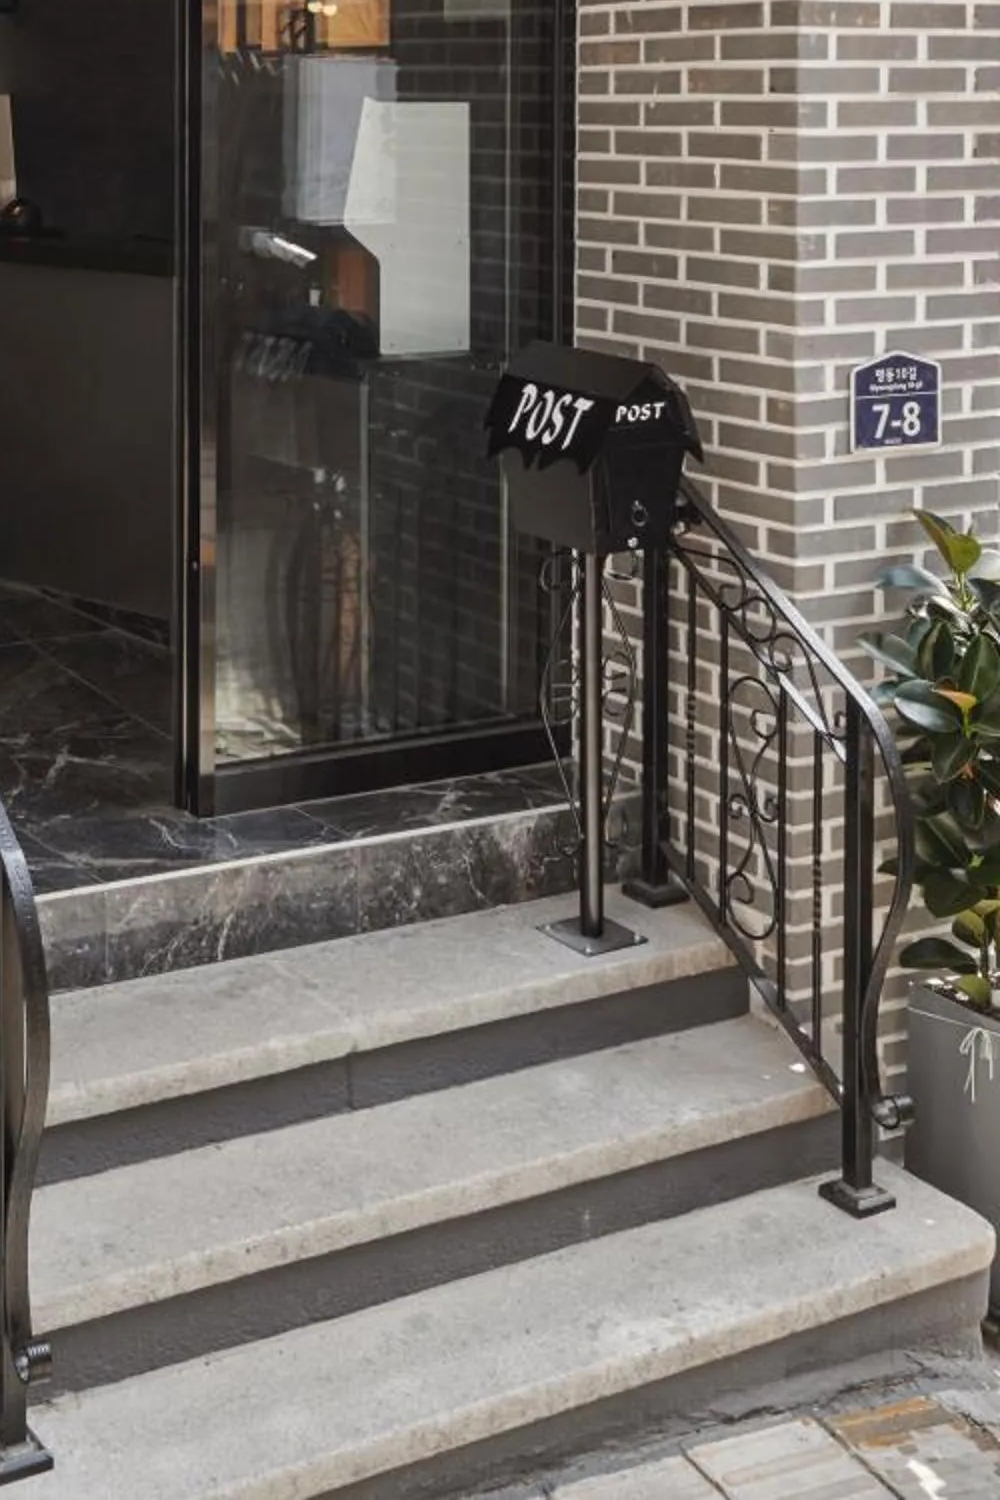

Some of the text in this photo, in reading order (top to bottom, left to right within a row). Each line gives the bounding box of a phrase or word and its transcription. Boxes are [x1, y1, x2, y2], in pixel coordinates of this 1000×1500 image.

[508, 383, 595, 450] POST
[615, 401, 665, 422] POST
[872, 401, 921, 439] 7-8
